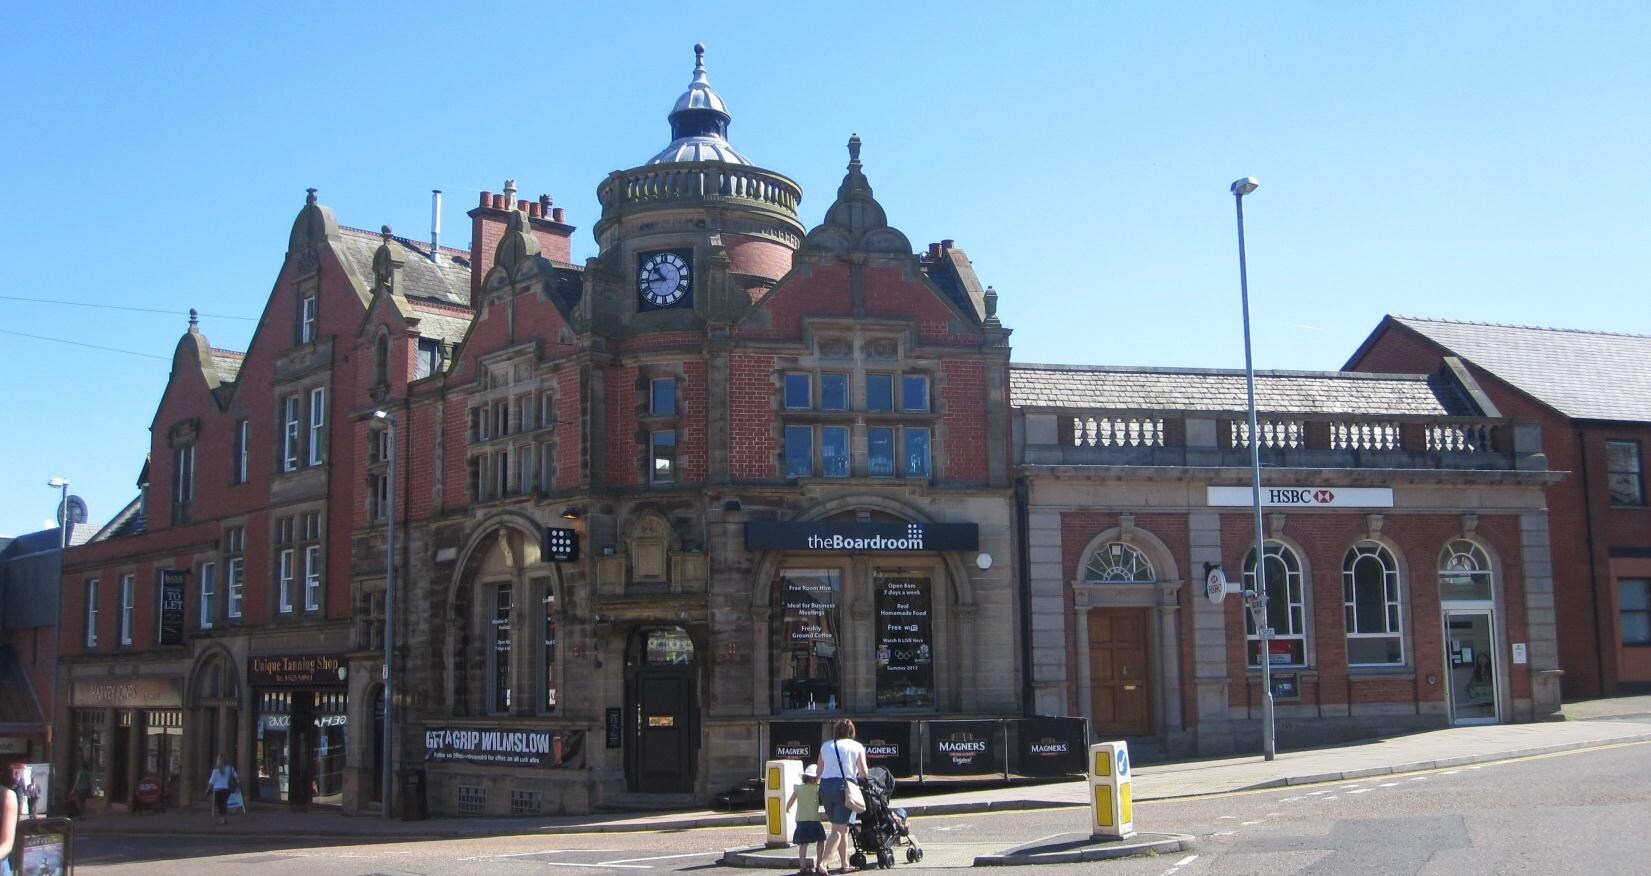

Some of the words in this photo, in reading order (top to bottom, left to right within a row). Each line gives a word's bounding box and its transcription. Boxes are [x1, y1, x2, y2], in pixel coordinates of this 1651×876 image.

[1269, 489, 1311, 503] HSBC
[808, 534, 923, 550] theBoardroom
[168, 592, 181, 600] TO
[165, 600, 184, 609] LET
[799, 609, 825, 617] Meetings
[254, 659, 281, 675] Unique
[283, 657, 315, 673] Tanning
[317, 656, 338, 672] Shop
[426, 730, 445, 748] GET
[445, 730, 452, 744] A
[453, 731, 479, 750] GRIP
[482, 732, 549, 753] WILMSLOW
[939, 741, 985, 752] MAGNERS
[777, 747, 808, 755] MAGNERS
[1031, 744, 1067, 752] MAGNERS
